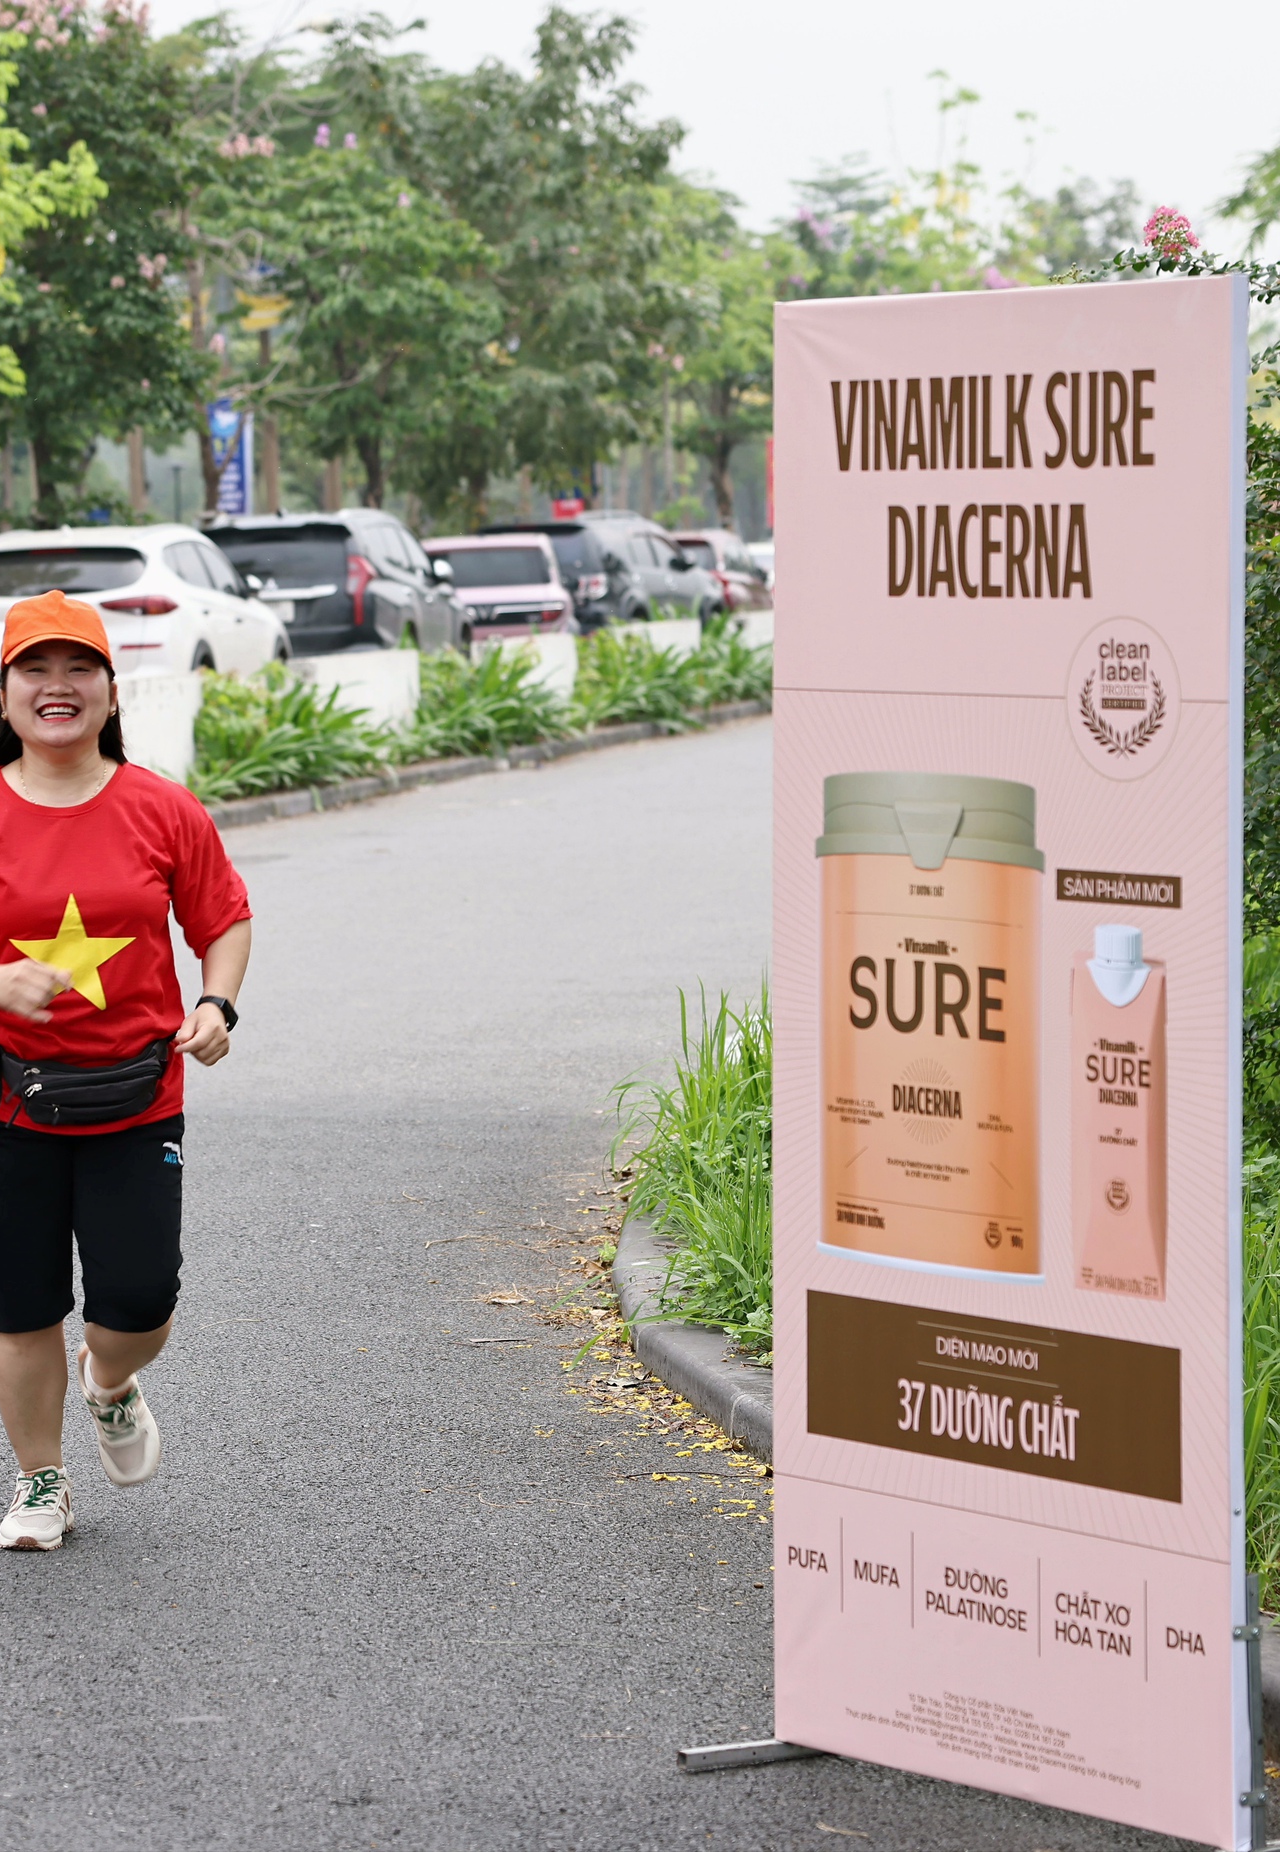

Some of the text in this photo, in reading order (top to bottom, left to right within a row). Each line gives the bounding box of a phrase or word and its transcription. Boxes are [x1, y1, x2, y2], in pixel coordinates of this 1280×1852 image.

[831, 369, 1156, 471] VINAMILK SURE
[888, 503, 1093, 599] DIACERNA
[1099, 638, 1150, 659] clean
[1101, 661, 1147, 681] label
[1063, 872, 1095, 897] SẢN
[1096, 873, 1141, 901] PHẨM
[904, 937, 950, 956] Vinamilk
[849, 955, 1007, 1043] SURE
[1086, 1053, 1152, 1089] SURE
[892, 1083, 963, 1120] DIACERNA
[936, 1335, 970, 1360] DIỆN
[971, 1342, 1007, 1366] MẠO
[898, 1378, 926, 1432] 37
[930, 1384, 1014, 1450] DƯỠNG
[787, 1546, 829, 1574] PUFA
[853, 1559, 900, 1589] MUFA
[944, 1566, 1009, 1599] ĐƯỜNG
[926, 1590, 1028, 1632] PALATINOSE
[1105, 1601, 1132, 1627] XƠ
[1055, 1619, 1131, 1657] HÒA TAN
[1166, 1626, 1206, 1656] DHA
